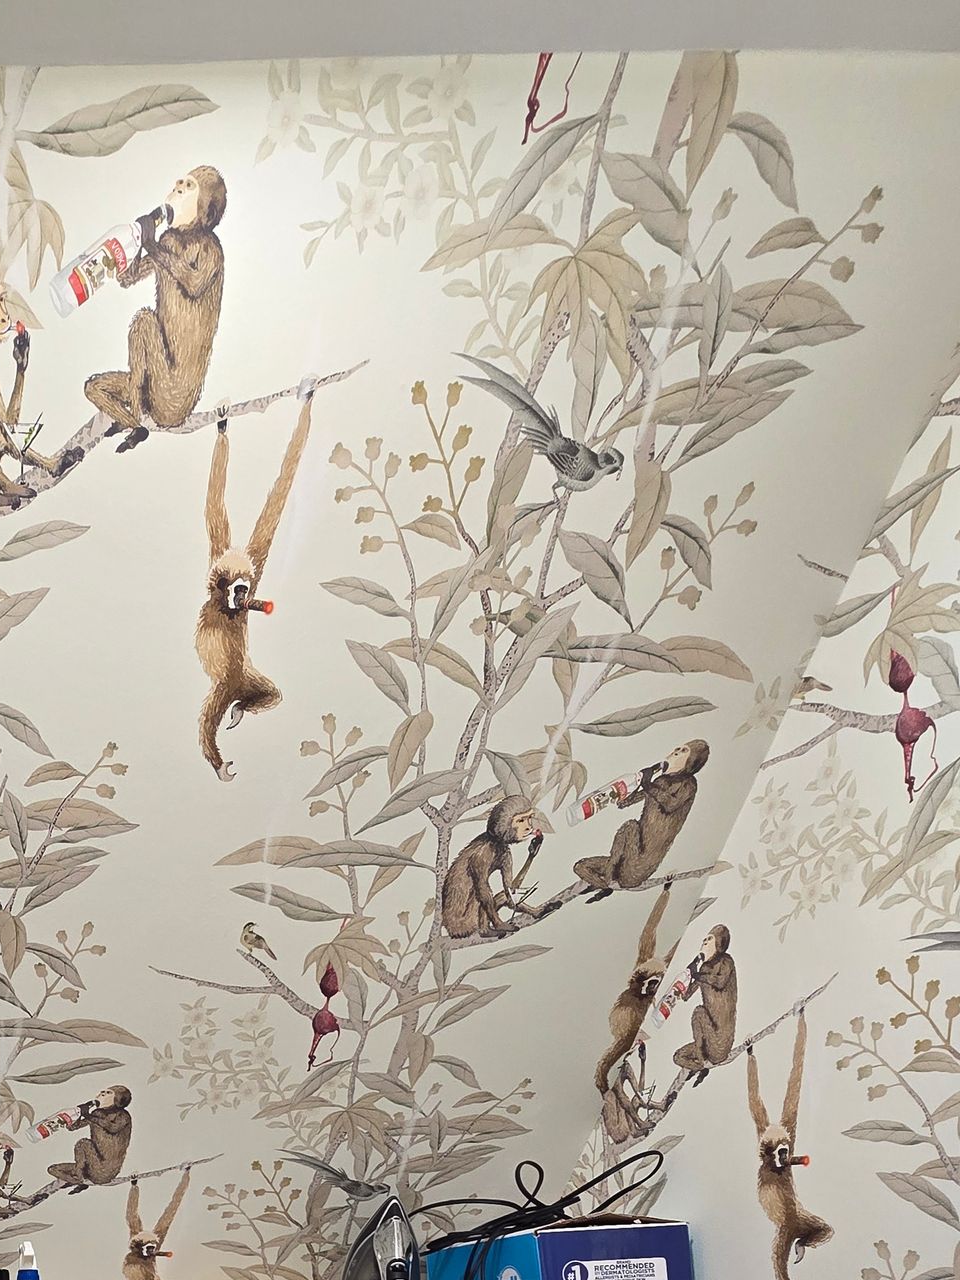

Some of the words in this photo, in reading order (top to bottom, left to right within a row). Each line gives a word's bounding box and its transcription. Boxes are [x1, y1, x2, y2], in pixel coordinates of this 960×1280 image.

[112, 241, 125, 272] VODKA
[594, 1262, 655, 1271] RECOMMENDED
[601, 1268, 655, 1276] DERMATOLOGISTS
